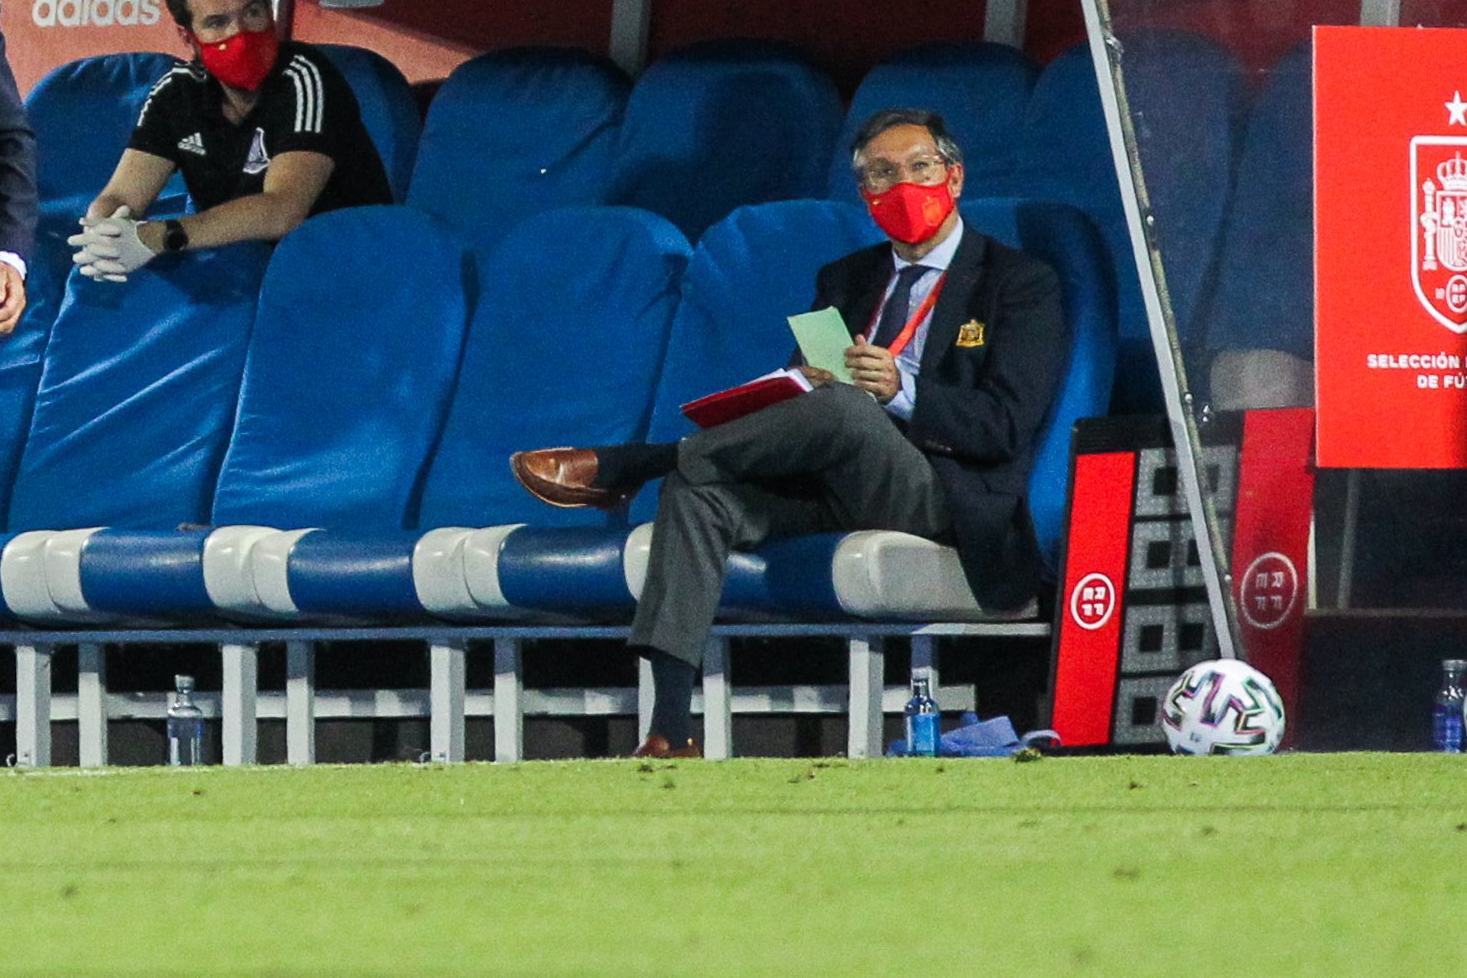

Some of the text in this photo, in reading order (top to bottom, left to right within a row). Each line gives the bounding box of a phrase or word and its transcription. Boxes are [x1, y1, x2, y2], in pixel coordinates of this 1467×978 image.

[1366, 351, 1461, 369] SELECCIÓN
[1417, 374, 1440, 389] DE
[1443, 371, 1467, 389] FÚ
